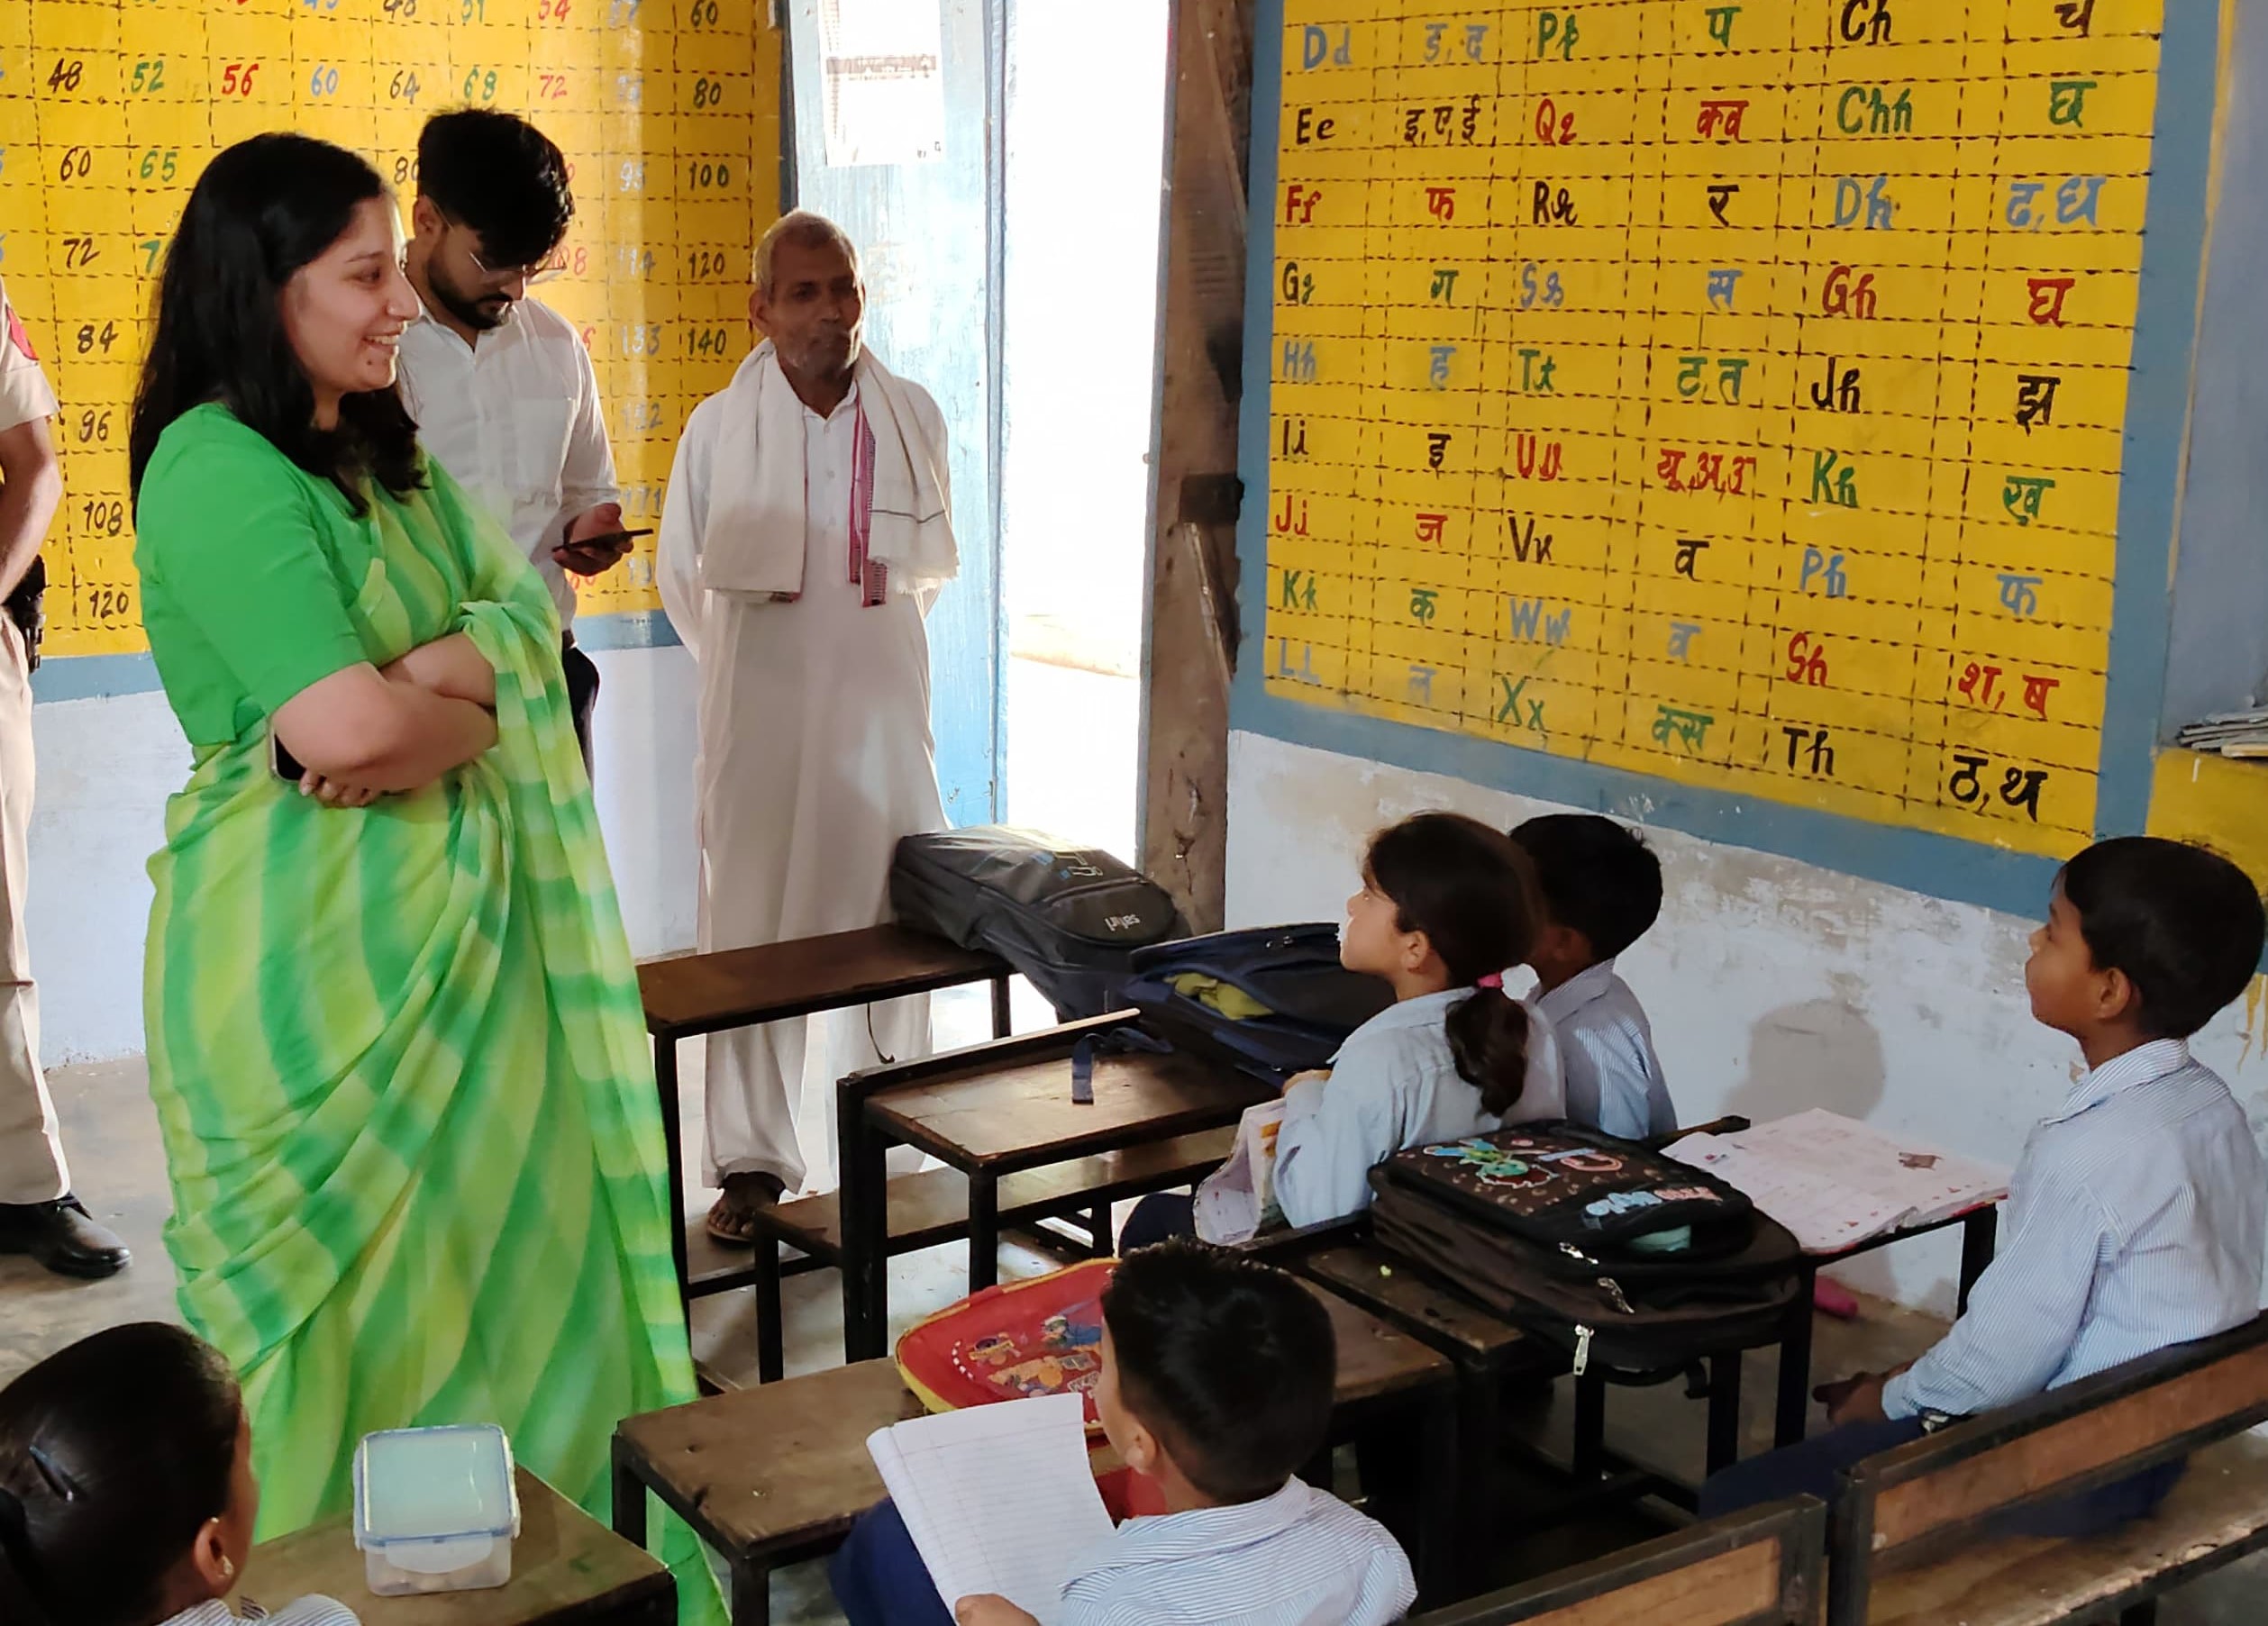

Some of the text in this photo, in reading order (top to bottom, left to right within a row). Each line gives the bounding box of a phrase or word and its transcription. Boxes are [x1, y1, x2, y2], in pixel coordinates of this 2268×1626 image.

[690, 0, 718, 28] 60
[1705, 6, 1741, 48] प
[1842, 0, 1891, 45] Ch
[1303, 25, 1353, 70] Dd
[48, 58, 84, 94] 48
[131, 60, 166, 94] 52
[222, 63, 260, 96] 56
[310, 64, 339, 97] 60
[389, 69, 421, 104] 64
[463, 68, 497, 101] 68
[539, 75, 568, 99] 72
[693, 77, 722, 108] 80
[1296, 108, 1337, 144] Ee
[1837, 86, 1912, 134] Chh
[59, 150, 91, 182] 60
[140, 150, 178, 182] 65
[689, 161, 729, 191] 100
[1286, 185, 1322, 223] Ff
[1707, 185, 1739, 227] र
[1835, 177, 1891, 230] Dh
[63, 238, 101, 269] 72
[139, 240, 160, 274] 7
[688, 252, 725, 277] 120
[1282, 261, 1316, 305] Gg
[1822, 265, 1877, 318] Gh
[2027, 277, 2075, 328] घ
[77, 321, 119, 354] 84
[621, 325, 661, 356] 133
[687, 328, 727, 355] 140
[1518, 349, 1556, 392] Tt
[1810, 356, 1861, 413] Jh
[2018, 376, 2061, 435] झ
[79, 409, 113, 442] 96
[1811, 450, 1858, 508] Kh
[83, 501, 123, 537] 108
[2002, 476, 2054, 526] ख
[1416, 513, 1448, 546] ज
[1674, 539, 1709, 582] व
[1800, 548, 1847, 598] Ph
[89, 590, 130, 620] 120
[1409, 588, 1438, 625] क
[1997, 574, 2043, 616] फ
[1787, 632, 1827, 687] Sh
[1782, 726, 1835, 777] Th
